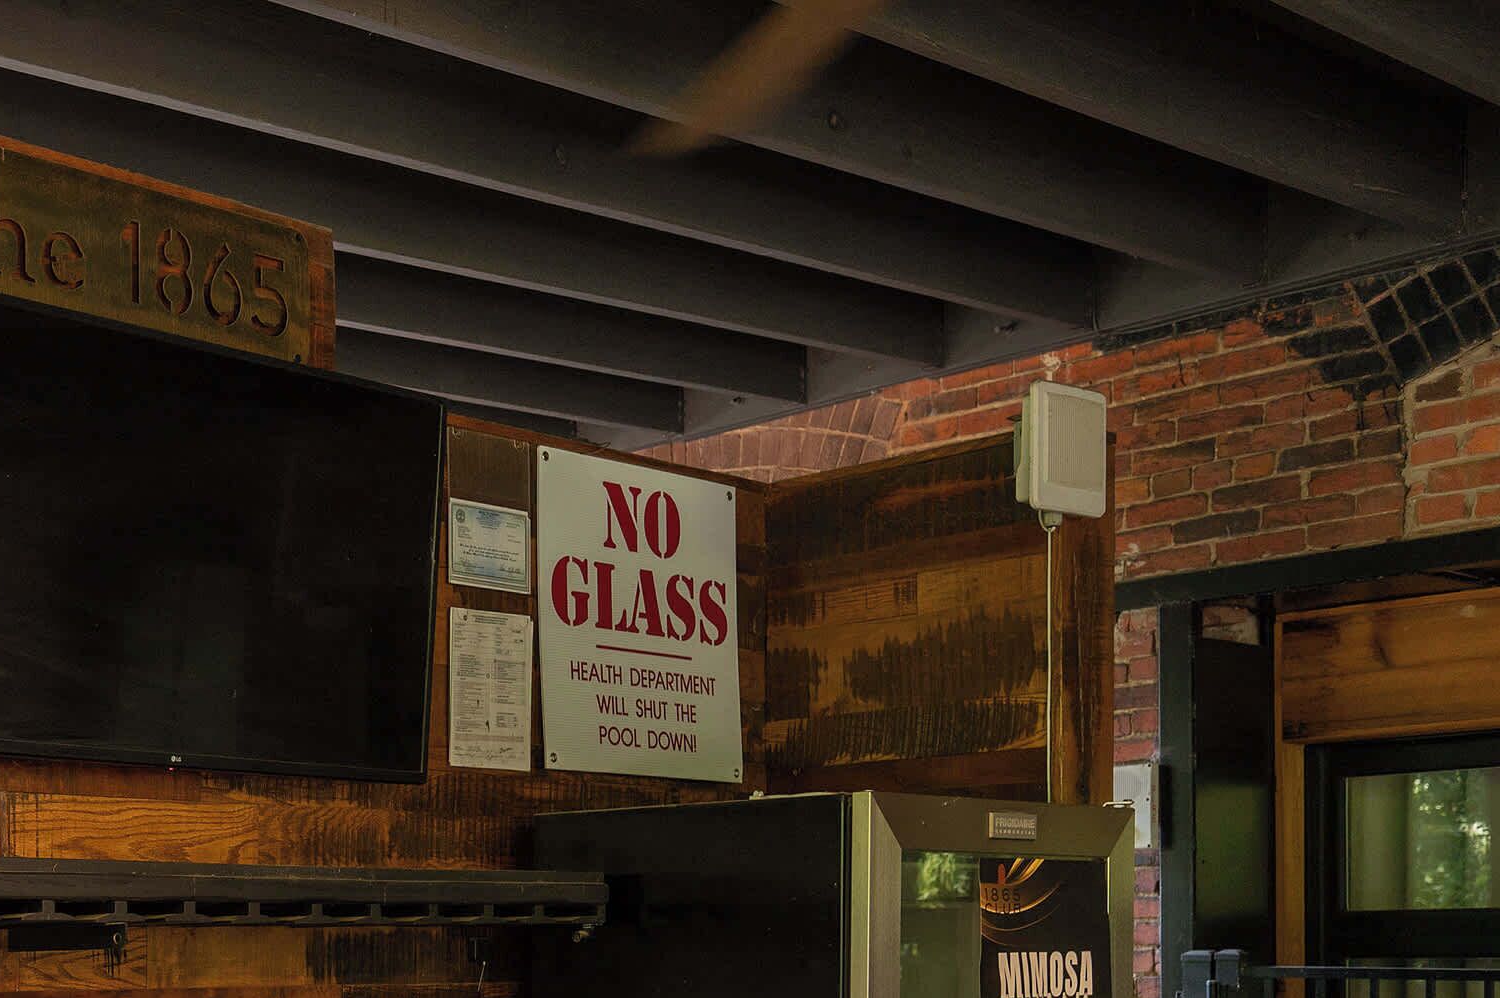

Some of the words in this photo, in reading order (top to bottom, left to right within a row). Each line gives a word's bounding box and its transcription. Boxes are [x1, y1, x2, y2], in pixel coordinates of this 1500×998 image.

[121, 219, 288, 337] 1865
[602, 480, 681, 559] NO
[551, 555, 728, 647] GLASS
[570, 660, 622, 685] HEALTH
[630, 667, 715, 696] DEPARTMENT
[596, 694, 628, 716] WILL
[636, 698, 668, 720] SHUT
[674, 703, 697, 723] THE
[599, 726, 641, 748] POOL
[648, 730, 697, 753] DOWN!
[996, 817, 1036, 829] FRIGIDAIRE
[984, 887, 1020, 902] 1865
[998, 951, 1093, 998] MIMOSA
